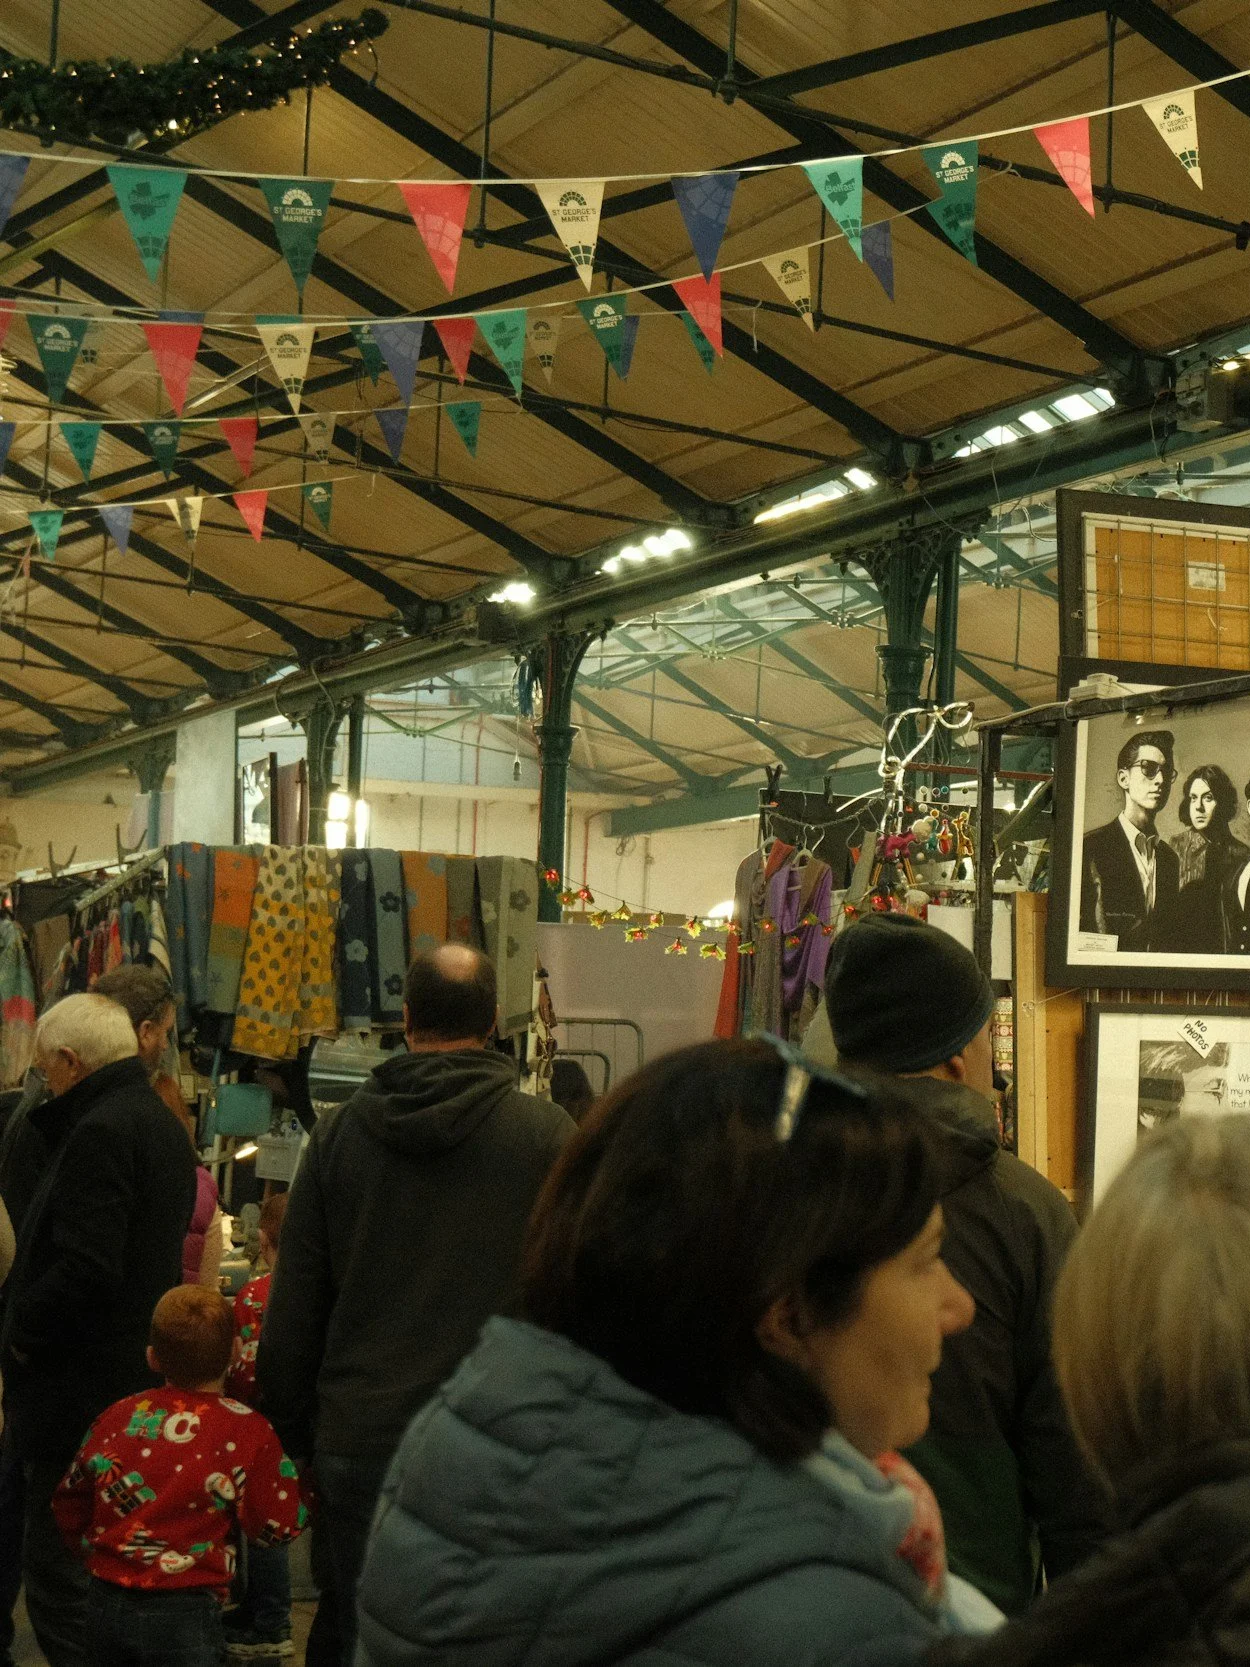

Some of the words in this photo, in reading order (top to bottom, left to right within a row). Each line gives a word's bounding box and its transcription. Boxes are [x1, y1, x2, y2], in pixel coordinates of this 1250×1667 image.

[1167, 115, 1194, 128] GEORGE'S
[1166, 123, 1189, 133] MARKET
[935, 170, 945, 179] ST
[945, 165, 975, 176] GEORGE'S
[943, 173, 969, 185] MARKET
[273, 206, 284, 214] ST
[285, 206, 322, 217] GEORGE'S
[562, 208, 597, 216] GEORGE'S
[282, 214, 314, 224] MARKET
[561, 216, 590, 224] MARKET
[784, 274, 804, 285] MARKET
[596, 313, 623, 324] GEORGE'S
[276, 352, 302, 360] MARKET
[1194, 1019, 1208, 1033] NO
[1183, 1023, 1210, 1051] PHOTOS
[1230, 1088, 1244, 1098] my
[1231, 1099, 1246, 1108] that
